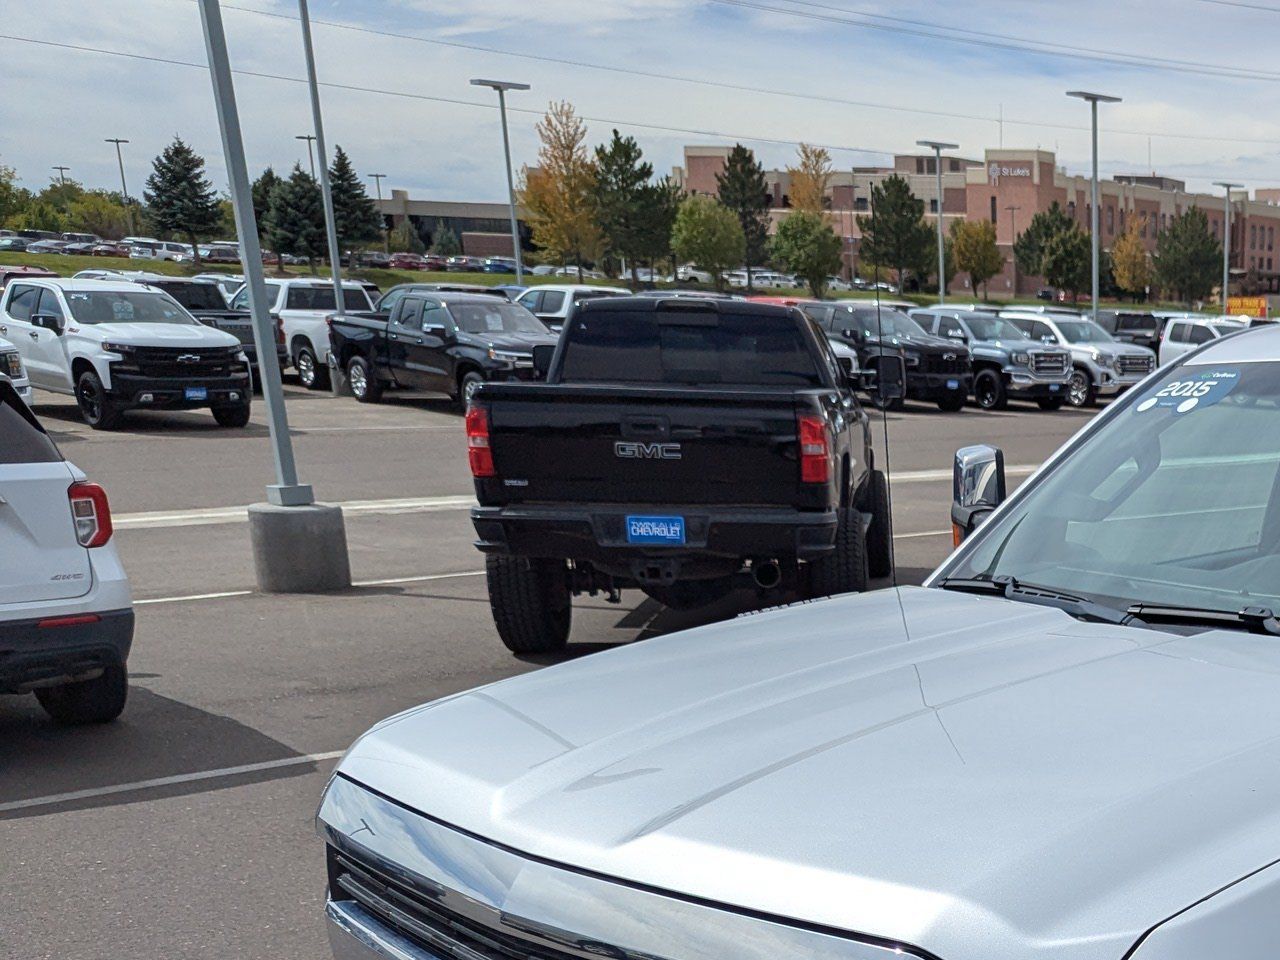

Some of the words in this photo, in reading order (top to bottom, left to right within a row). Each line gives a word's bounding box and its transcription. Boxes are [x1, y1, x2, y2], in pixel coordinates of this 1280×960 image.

[1155, 380, 1218, 397] 2015
[614, 441, 682, 460] GMC
[631, 526, 680, 537] CHEVROLET
[50, 573, 84, 581] 4WD
